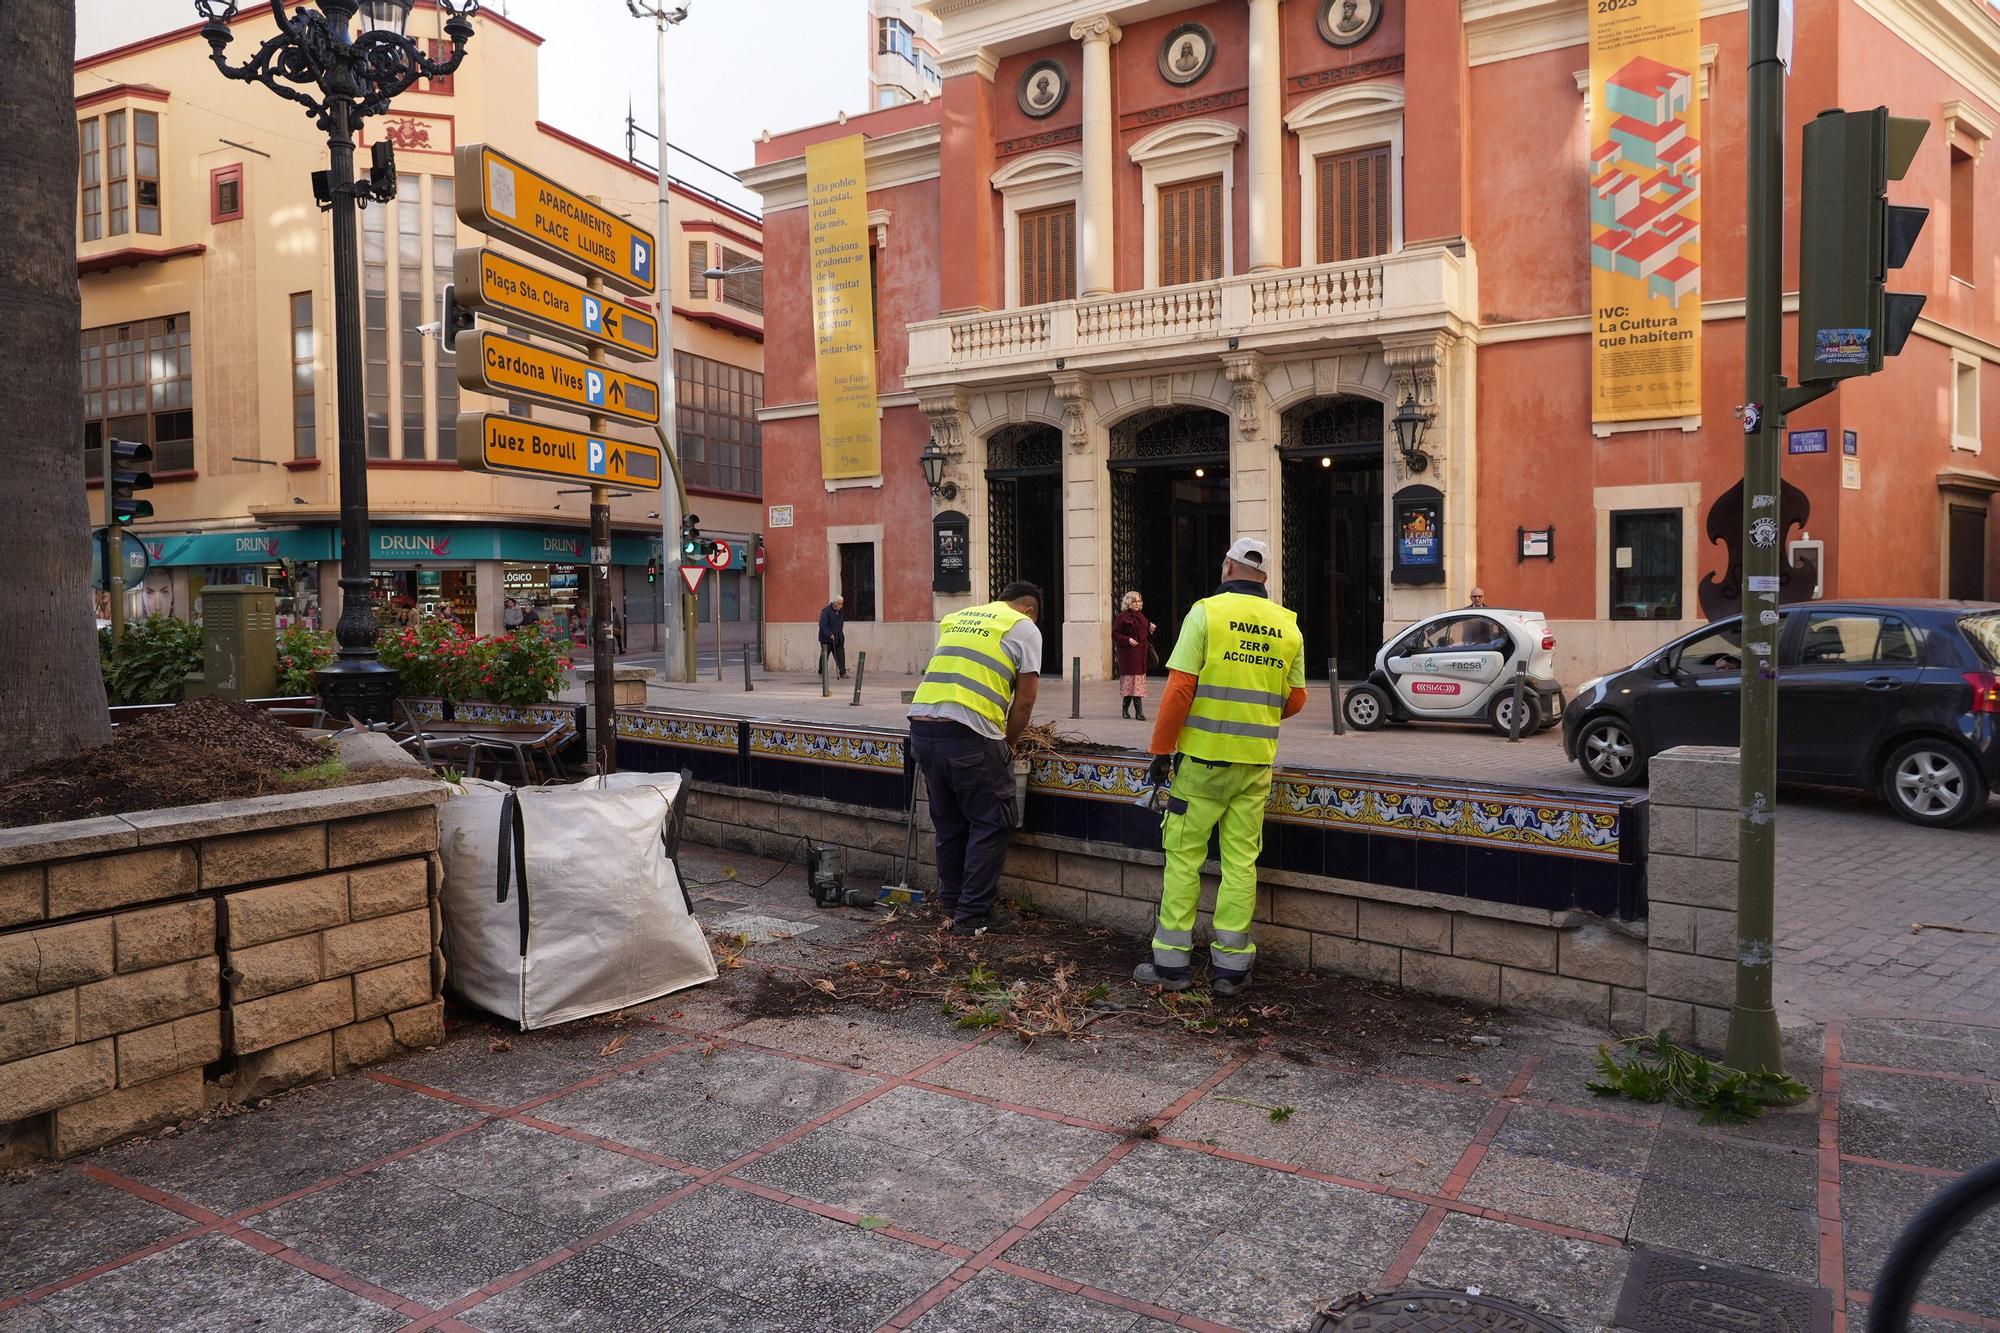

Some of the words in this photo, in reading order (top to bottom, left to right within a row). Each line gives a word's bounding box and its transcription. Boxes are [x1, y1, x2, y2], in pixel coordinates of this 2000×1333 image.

[538, 189, 612, 239] APARCAMENTS
[819, 207, 836, 217] cada
[815, 221, 826, 231] dia
[535, 213, 569, 242] PLACE
[577, 233, 616, 264] LLIURES
[634, 242, 646, 271] P
[815, 242, 860, 256] condicions
[816, 272, 826, 281] de
[828, 271, 835, 279] la
[817, 280, 860, 293] malignitat
[485, 266, 516, 296] Plaça
[520, 279, 540, 303] Sta.
[543, 288, 569, 312] Clara
[585, 298, 598, 328] P
[1599, 306, 1629, 319] IVC:
[1599, 322, 1617, 333] La
[1620, 317, 1678, 331] Cultura
[1599, 336, 1626, 349] que
[1630, 329, 1693, 345] habitem
[486, 347, 545, 381] Cardona
[551, 365, 583, 391] Vives
[588, 372, 601, 401] P
[490, 428, 525, 452] Juez
[532, 433, 576, 461] Borull
[590, 443, 603, 472] P
[236, 537, 270, 551] DRUNI
[380, 535, 435, 550] DRUNI
[543, 537, 576, 552] DRUNI
[1229, 621, 1283, 639] PAVASAL
[1239, 640, 1270, 653] ZERO
[1223, 651, 1284, 669] ACCIDENTS
